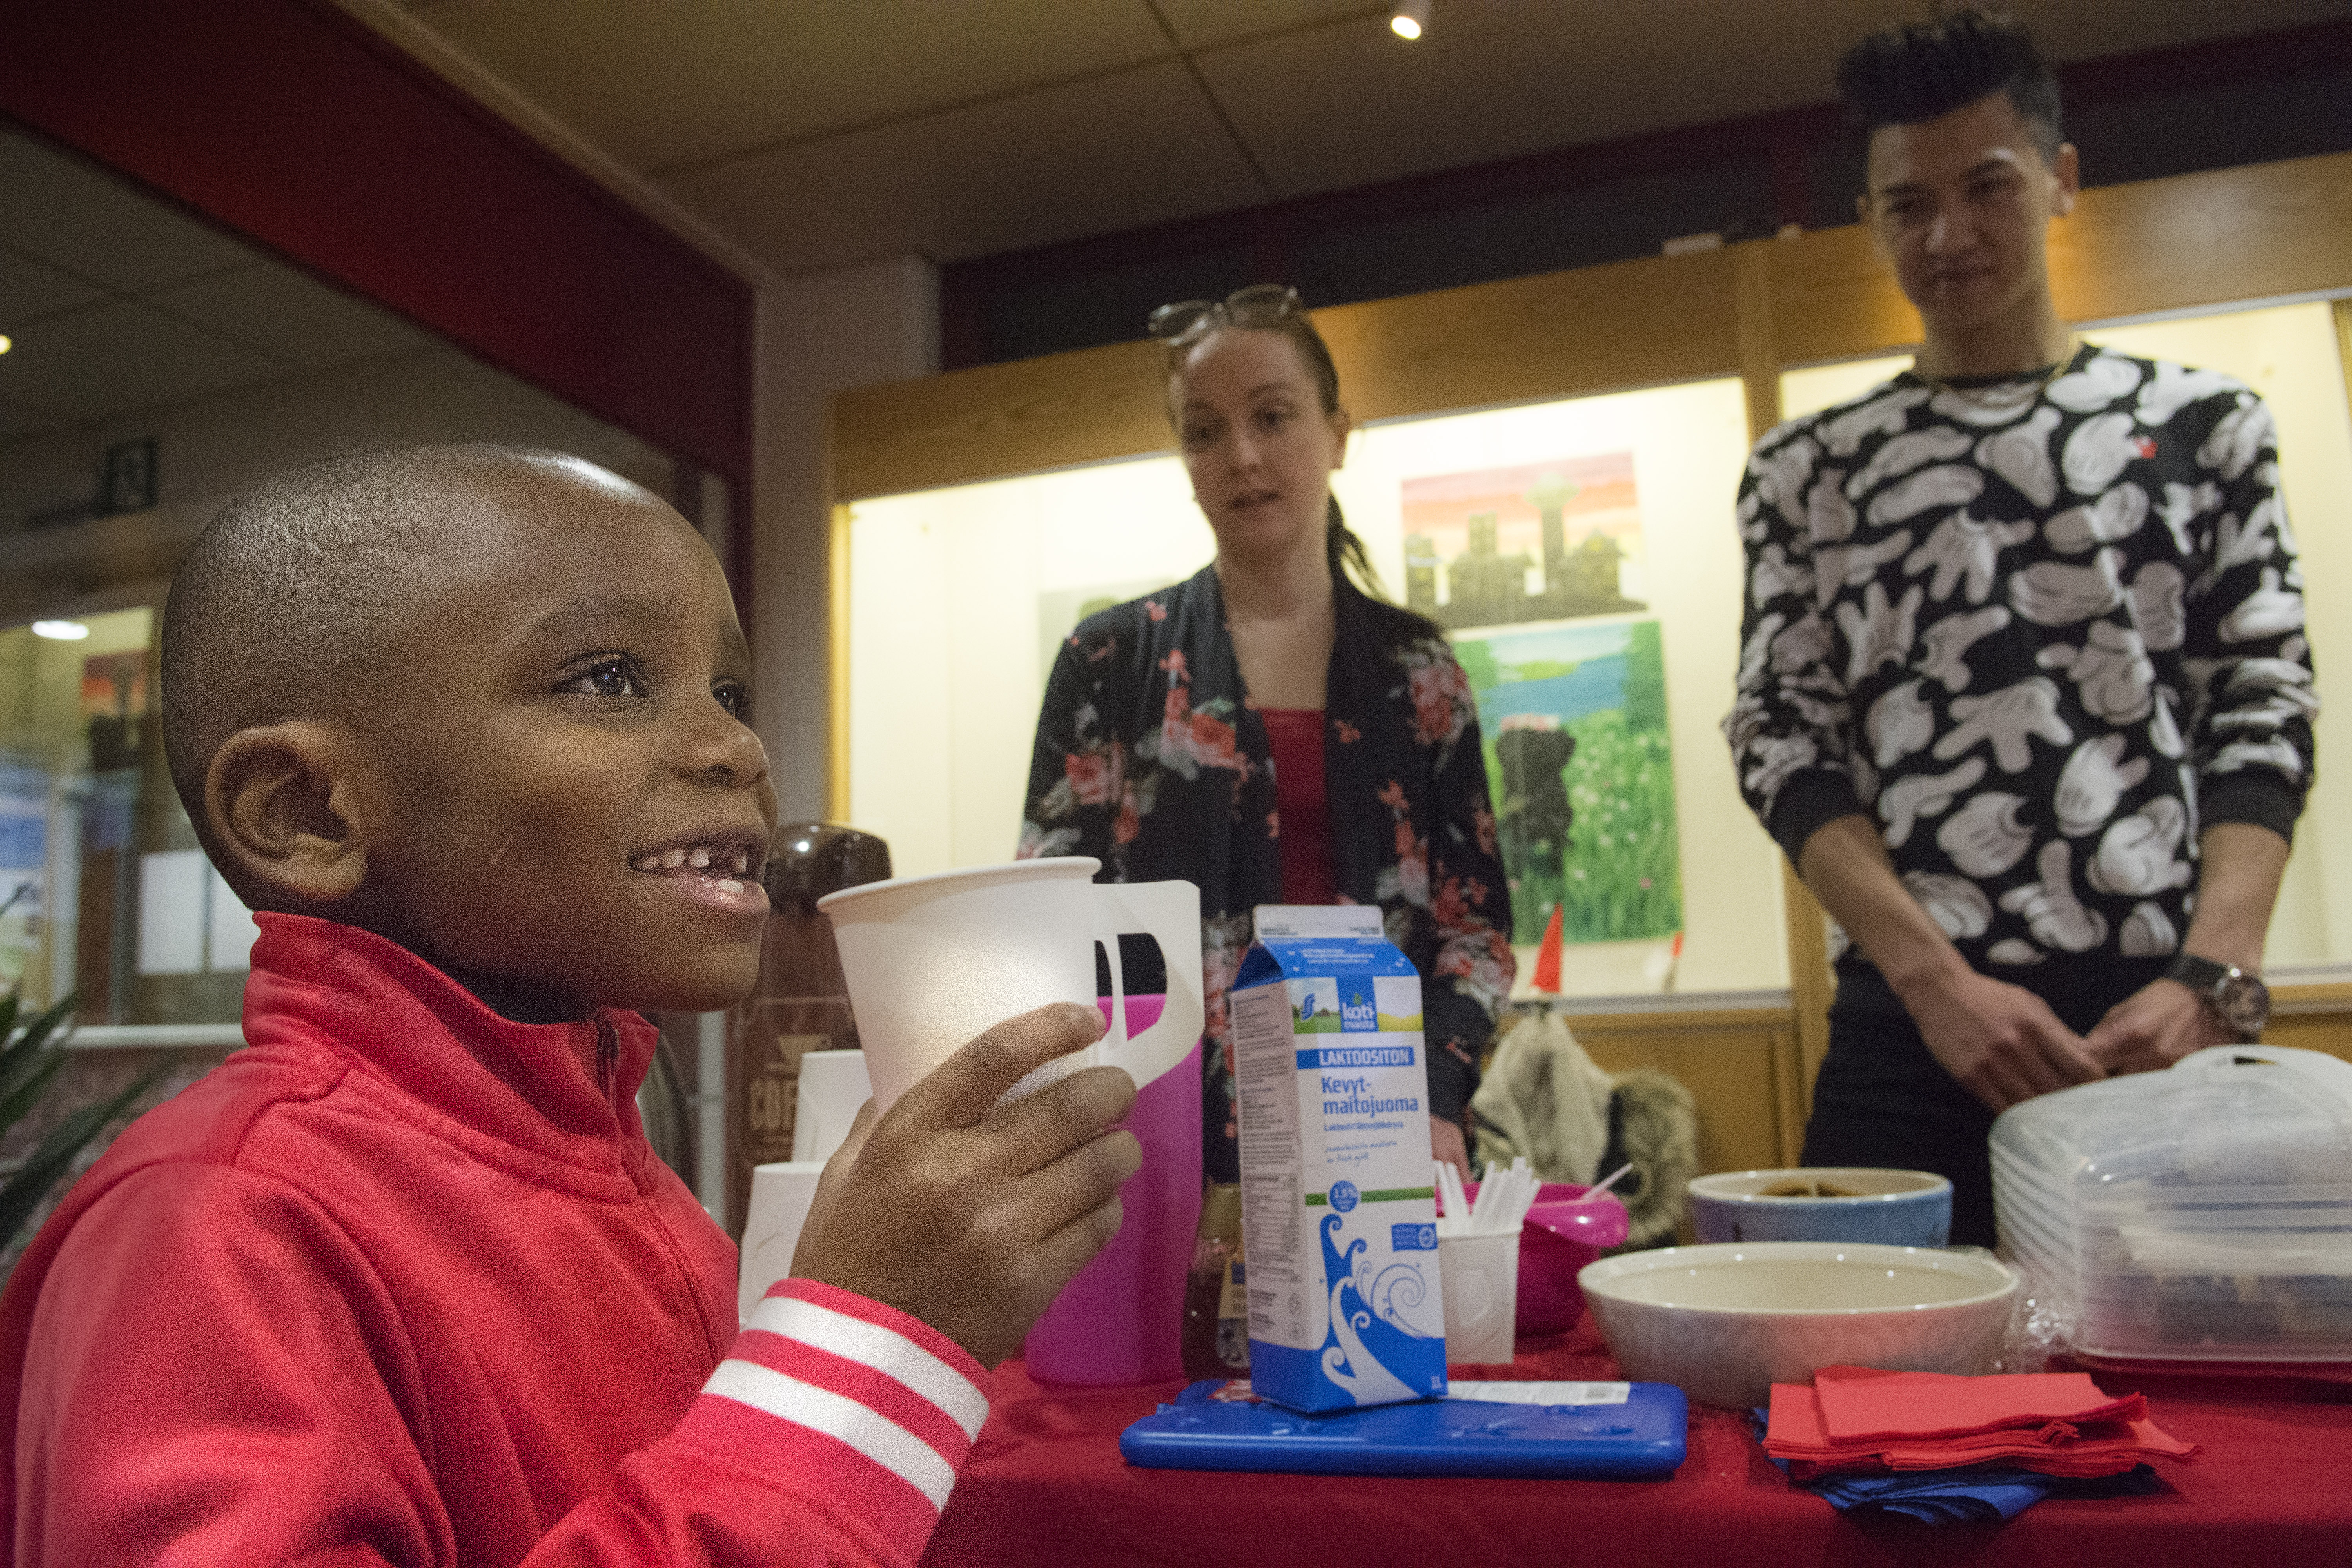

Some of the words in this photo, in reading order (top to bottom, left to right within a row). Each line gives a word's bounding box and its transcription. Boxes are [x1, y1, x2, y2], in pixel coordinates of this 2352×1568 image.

[1319, 1049, 1409, 1066] LAKTOOSITON
[1321, 1076, 1371, 1097] Kevyt-
[1323, 1095, 1419, 1118] maitojuoma
